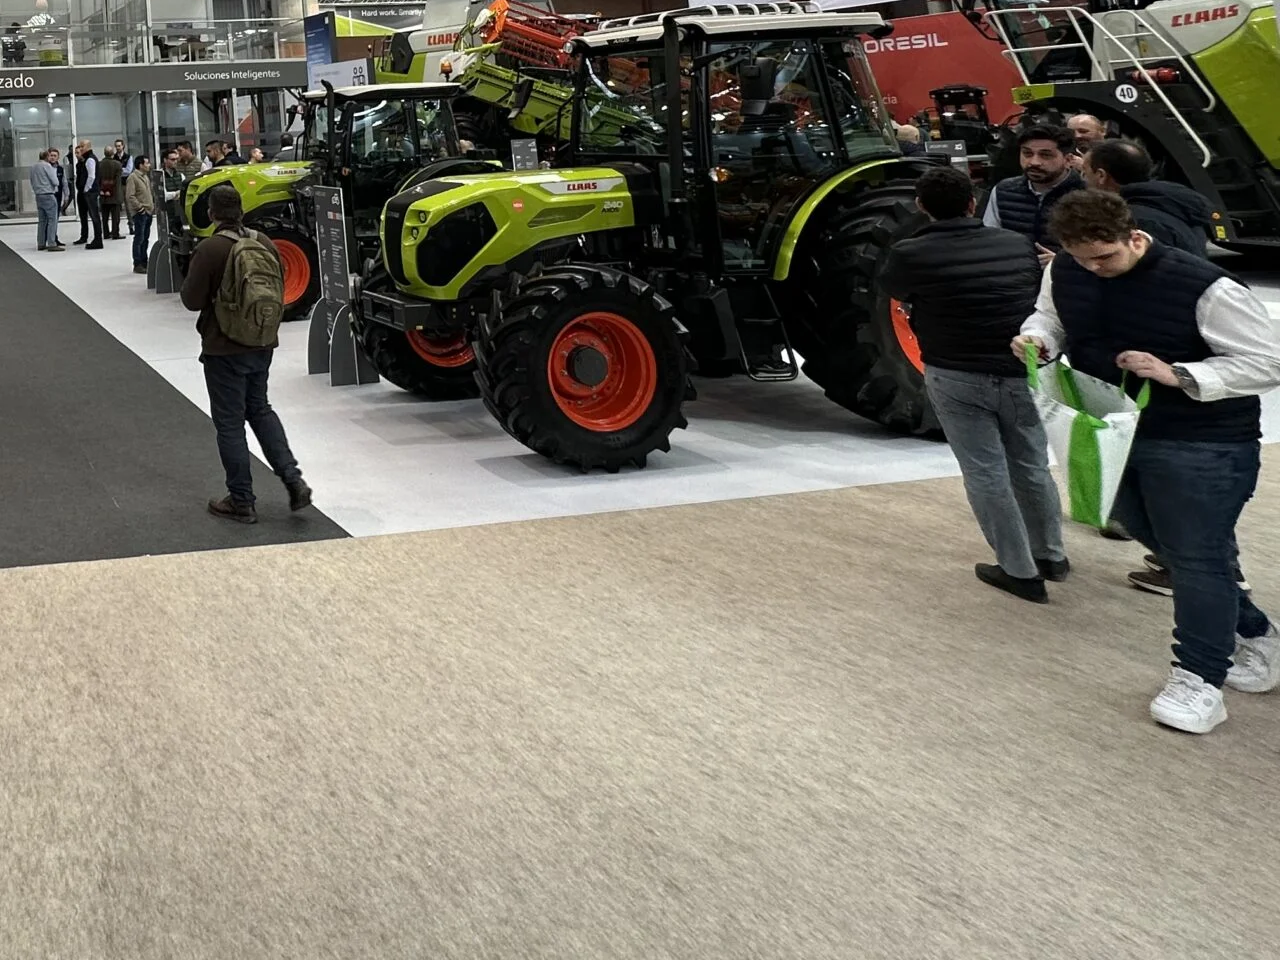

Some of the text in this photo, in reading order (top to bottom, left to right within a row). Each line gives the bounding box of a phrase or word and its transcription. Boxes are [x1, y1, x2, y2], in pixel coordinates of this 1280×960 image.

[1171, 4, 1240, 28] CLAAS
[863, 33, 949, 54] ORESIL
[184, 70, 280, 80] Soluciones Inteligentes
[1119, 87, 1134, 99] 40
[566, 182, 598, 191] CLAAS
